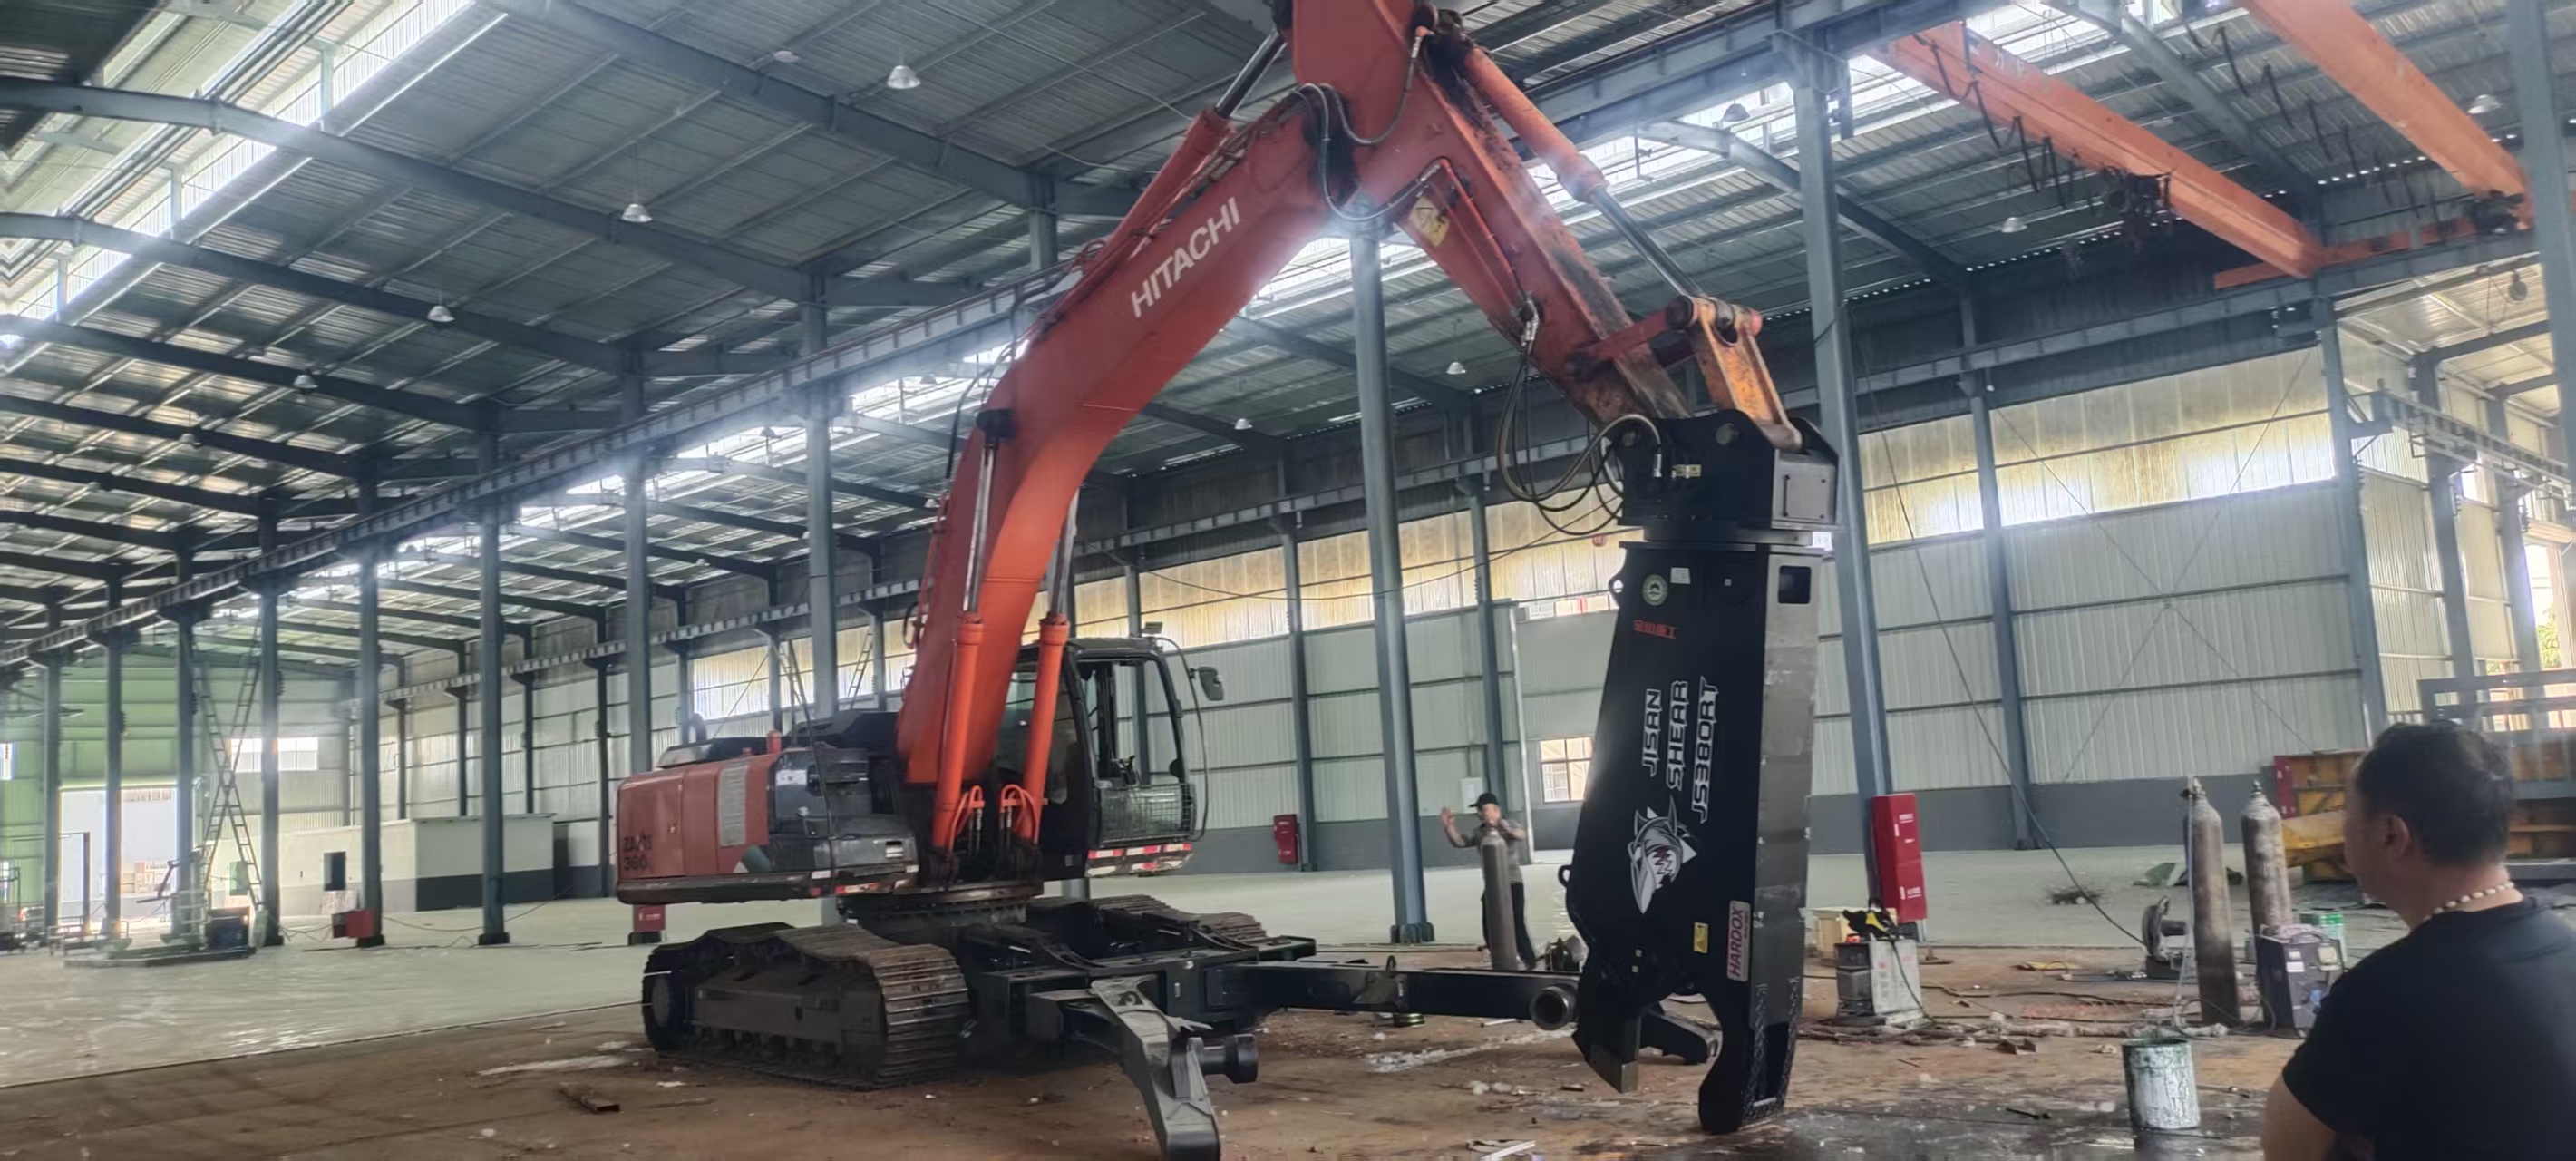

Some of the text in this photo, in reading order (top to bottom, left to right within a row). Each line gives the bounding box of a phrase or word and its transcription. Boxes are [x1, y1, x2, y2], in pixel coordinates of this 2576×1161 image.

[1131, 197, 1240, 318] HITACHI
[1642, 688, 1662, 777] JISAN
[1667, 680, 1689, 792] SHEAR
[1729, 907, 1744, 977] HARDOX
